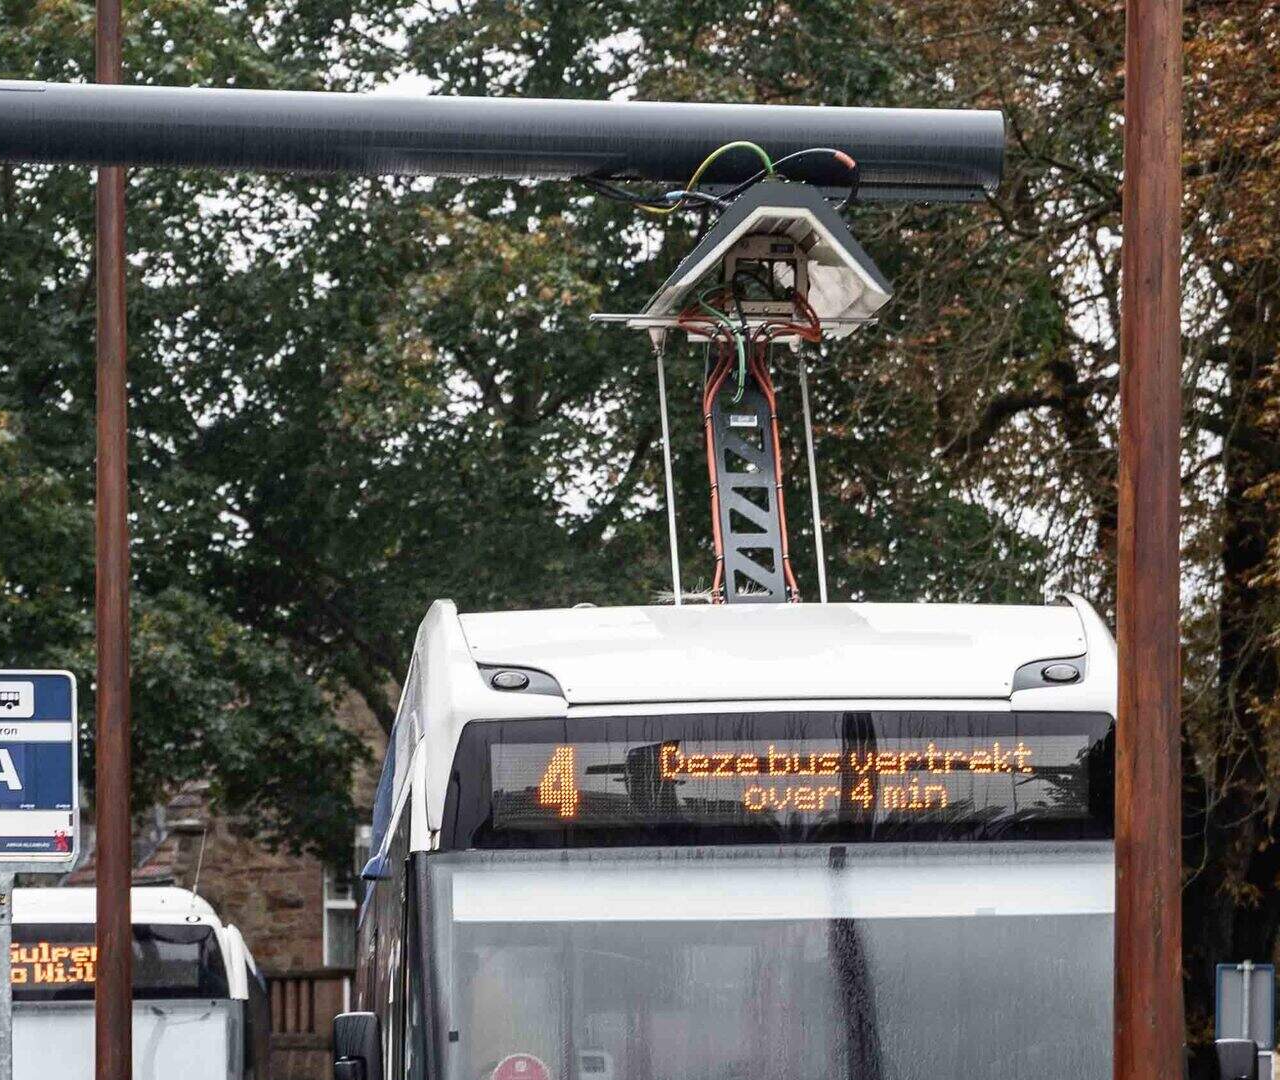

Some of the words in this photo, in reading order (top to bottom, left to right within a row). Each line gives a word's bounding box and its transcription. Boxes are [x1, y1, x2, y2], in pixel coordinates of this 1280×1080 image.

[659, 745, 759, 778] Deze
[768, 744, 840, 775] bus
[850, 742, 1033, 774] vertrekt
[537, 745, 580, 818] 4
[743, 784, 841, 811] over
[851, 778, 874, 809] 4
[881, 777, 949, 811] min
